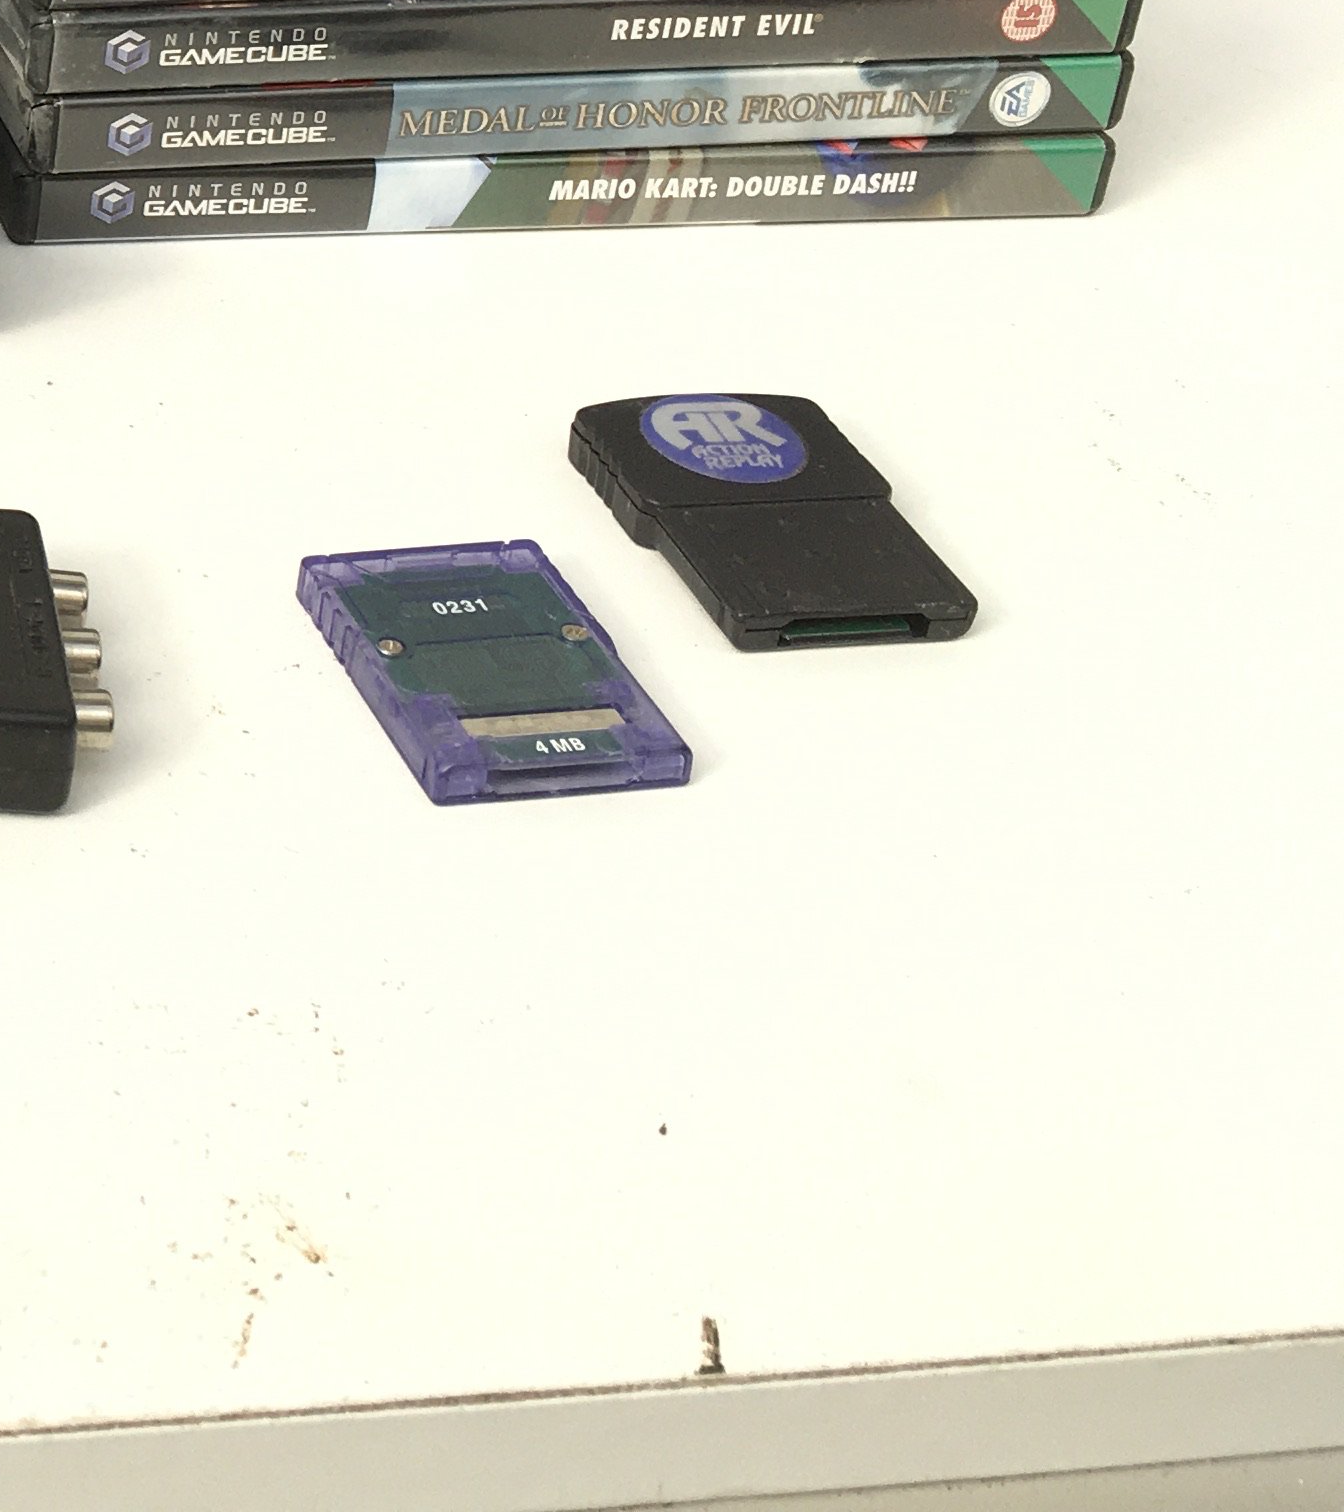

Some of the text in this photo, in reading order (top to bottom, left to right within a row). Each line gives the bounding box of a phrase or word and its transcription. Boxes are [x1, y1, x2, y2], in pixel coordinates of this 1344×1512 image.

[164, 26, 328, 47] NINTENDO
[610, 14, 747, 41] RESIDENT
[999, 80, 1027, 117] EA
[166, 109, 328, 130] NINTENDO
[398, 104, 536, 138] MEDAL
[540, 103, 571, 122] OF
[574, 95, 728, 131] HONOR
[148, 180, 308, 199] NINTENDO
[548, 170, 918, 201] MARIO KART: DOUBLE DASH!!
[650, 401, 789, 451] AR
[691, 442, 771, 460] ACTION
[703, 454, 785, 471] REPLAY
[432, 598, 489, 615] 0231
[535, 737, 586, 755] 4 MB
